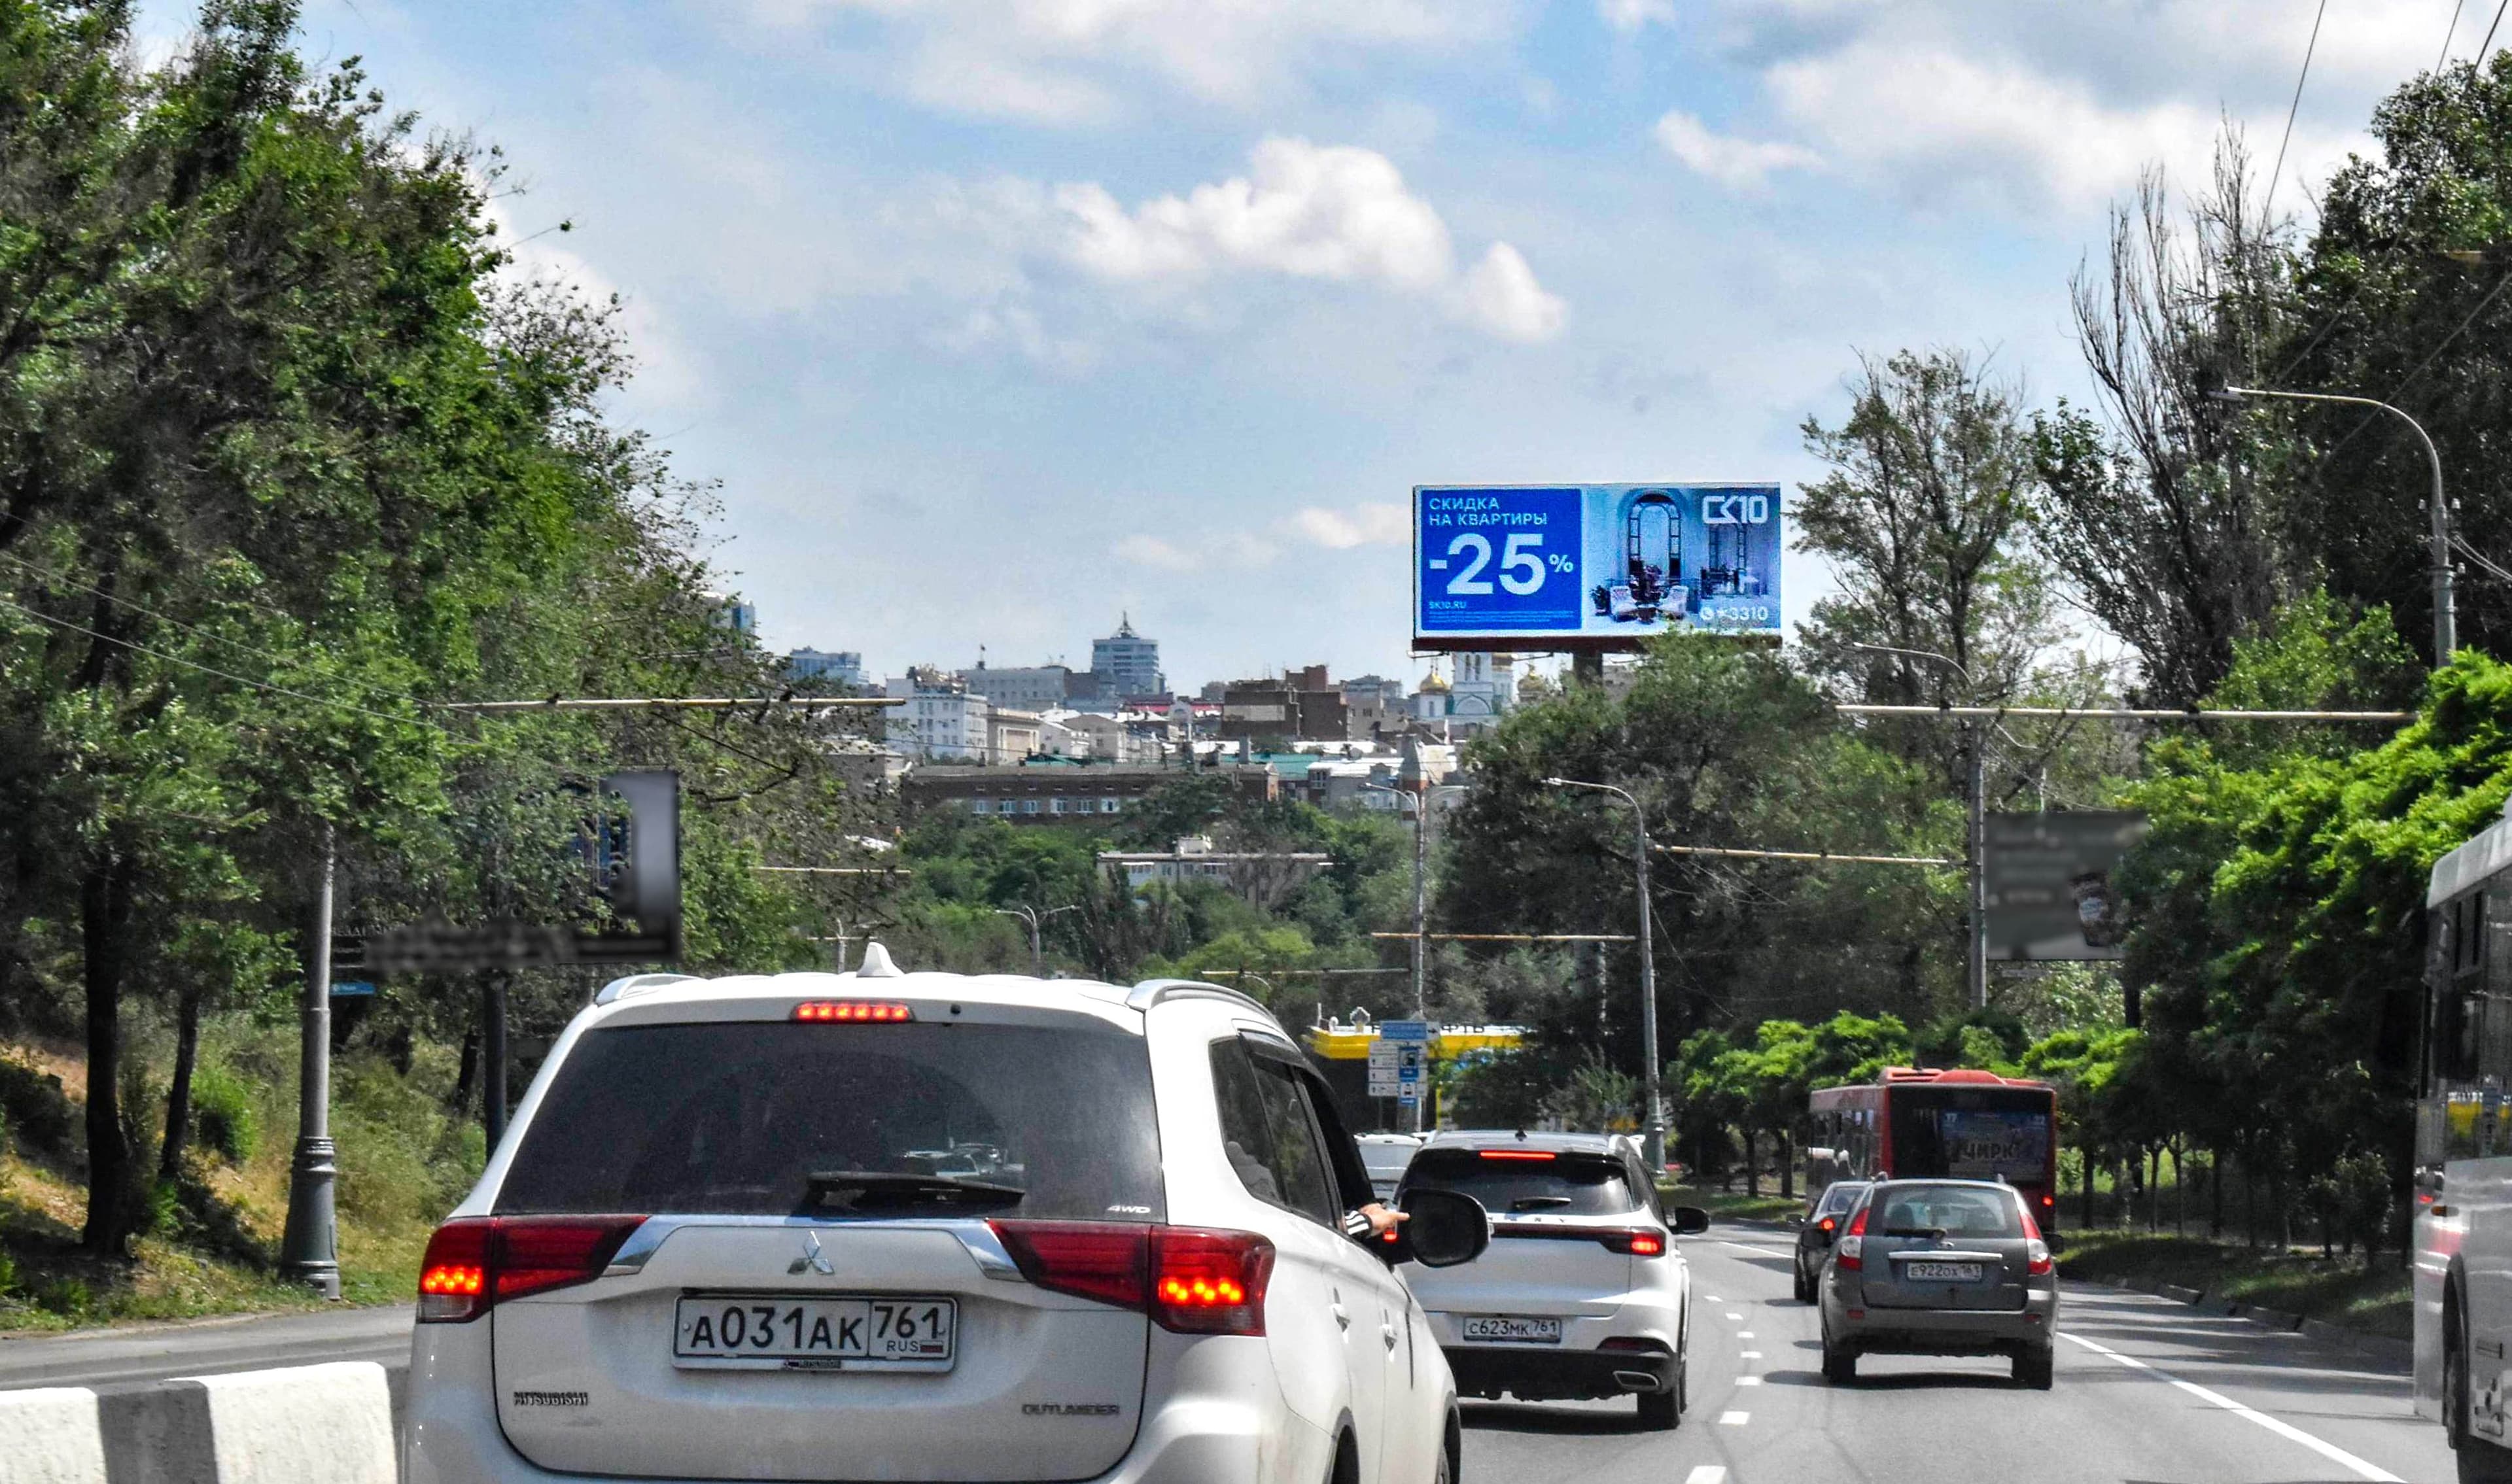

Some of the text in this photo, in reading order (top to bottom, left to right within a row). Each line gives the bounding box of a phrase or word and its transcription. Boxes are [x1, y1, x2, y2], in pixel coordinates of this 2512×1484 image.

[1429, 497, 1500, 512] СКИДКА
[1429, 512, 1548, 526] НА КВАРТИРЫ
[1107, 1205, 1151, 1214] 4WD
[690, 1305, 939, 1350] А031АК 761
[1469, 1319, 1557, 1336] С623МК 761
[886, 1340, 919, 1353] RUS
